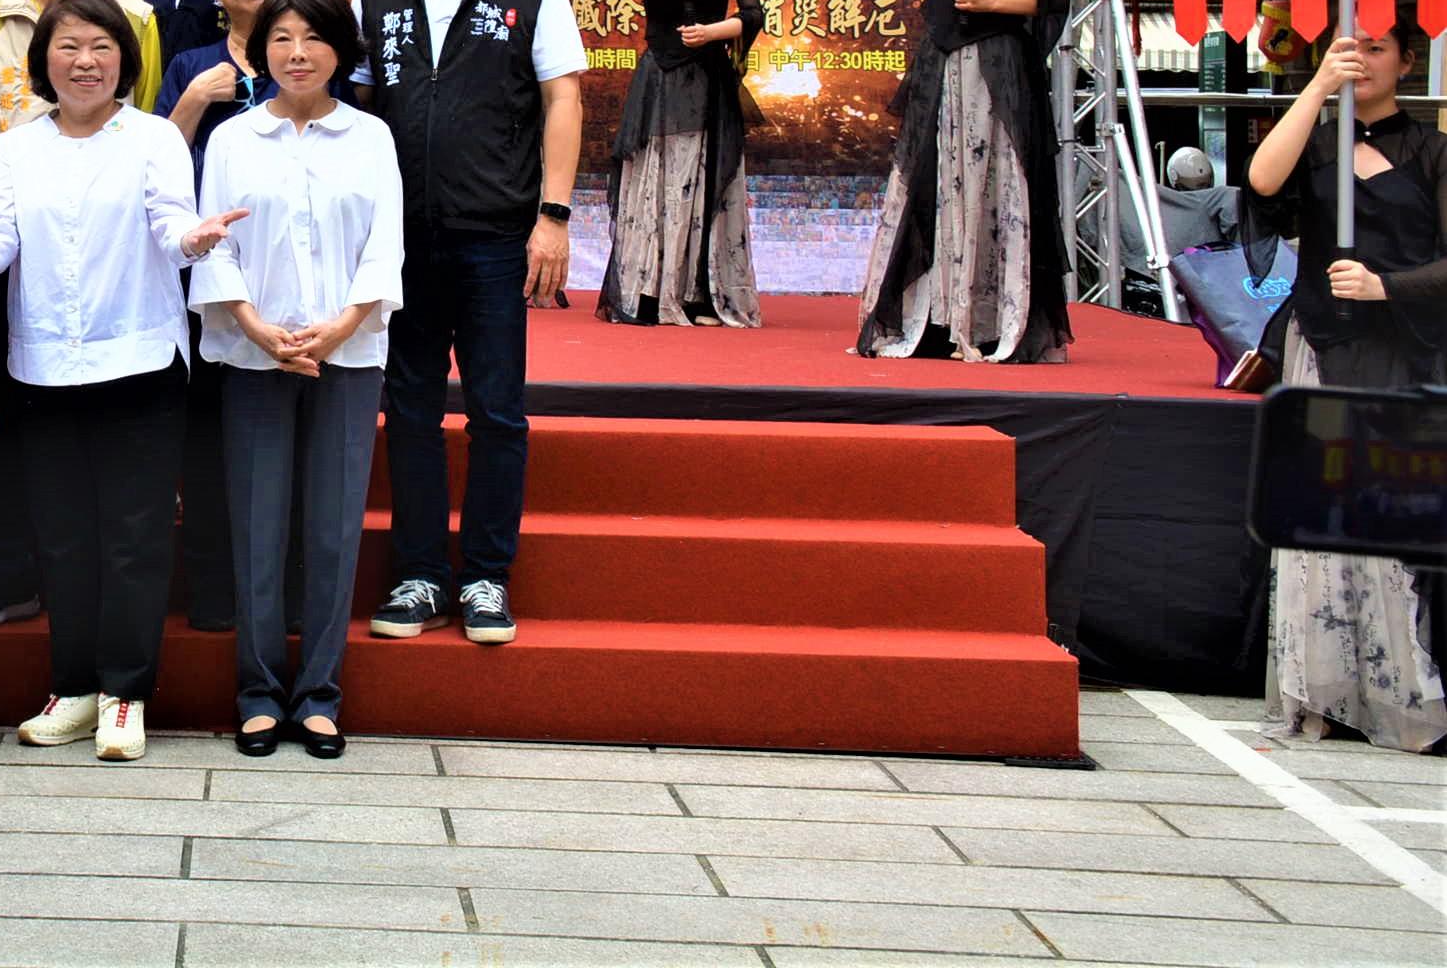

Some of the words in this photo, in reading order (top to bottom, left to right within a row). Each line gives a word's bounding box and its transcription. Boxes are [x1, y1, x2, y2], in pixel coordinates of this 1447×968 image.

[401, 8, 415, 45] 管理人
[382, 11, 403, 87] 鄭來聖
[769, 49, 906, 72] 中午12:30時起
